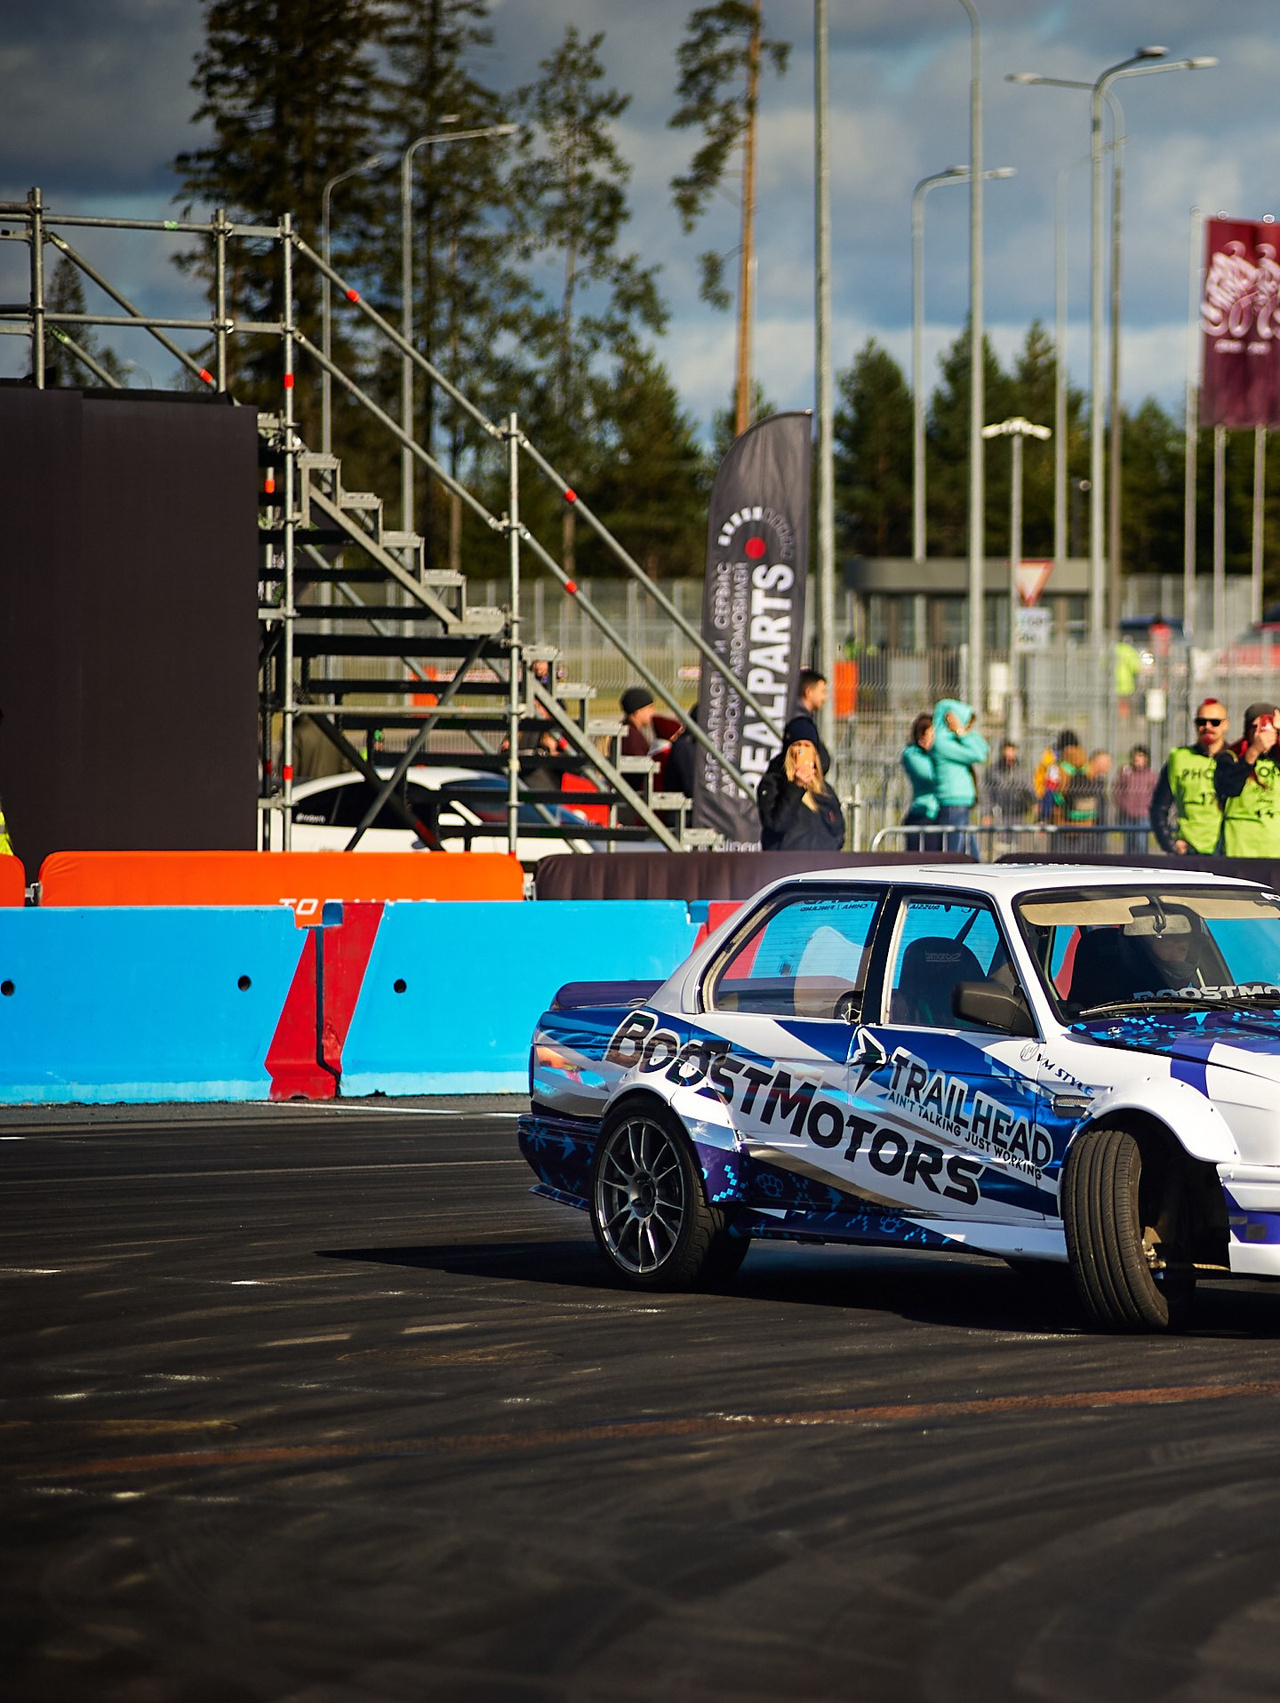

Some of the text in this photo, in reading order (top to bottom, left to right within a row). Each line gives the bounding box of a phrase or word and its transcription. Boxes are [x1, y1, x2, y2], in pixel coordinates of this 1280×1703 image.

[714, 560, 733, 630] СЕРВИС
[604, 1012, 983, 1205] BOOSTMOTORS
[890, 1051, 1052, 1168] TRAILHEAD
[1055, 1068, 1095, 1097] STYLE
[888, 1091, 1042, 1180] AIN'T TALKING JUST WORKING
